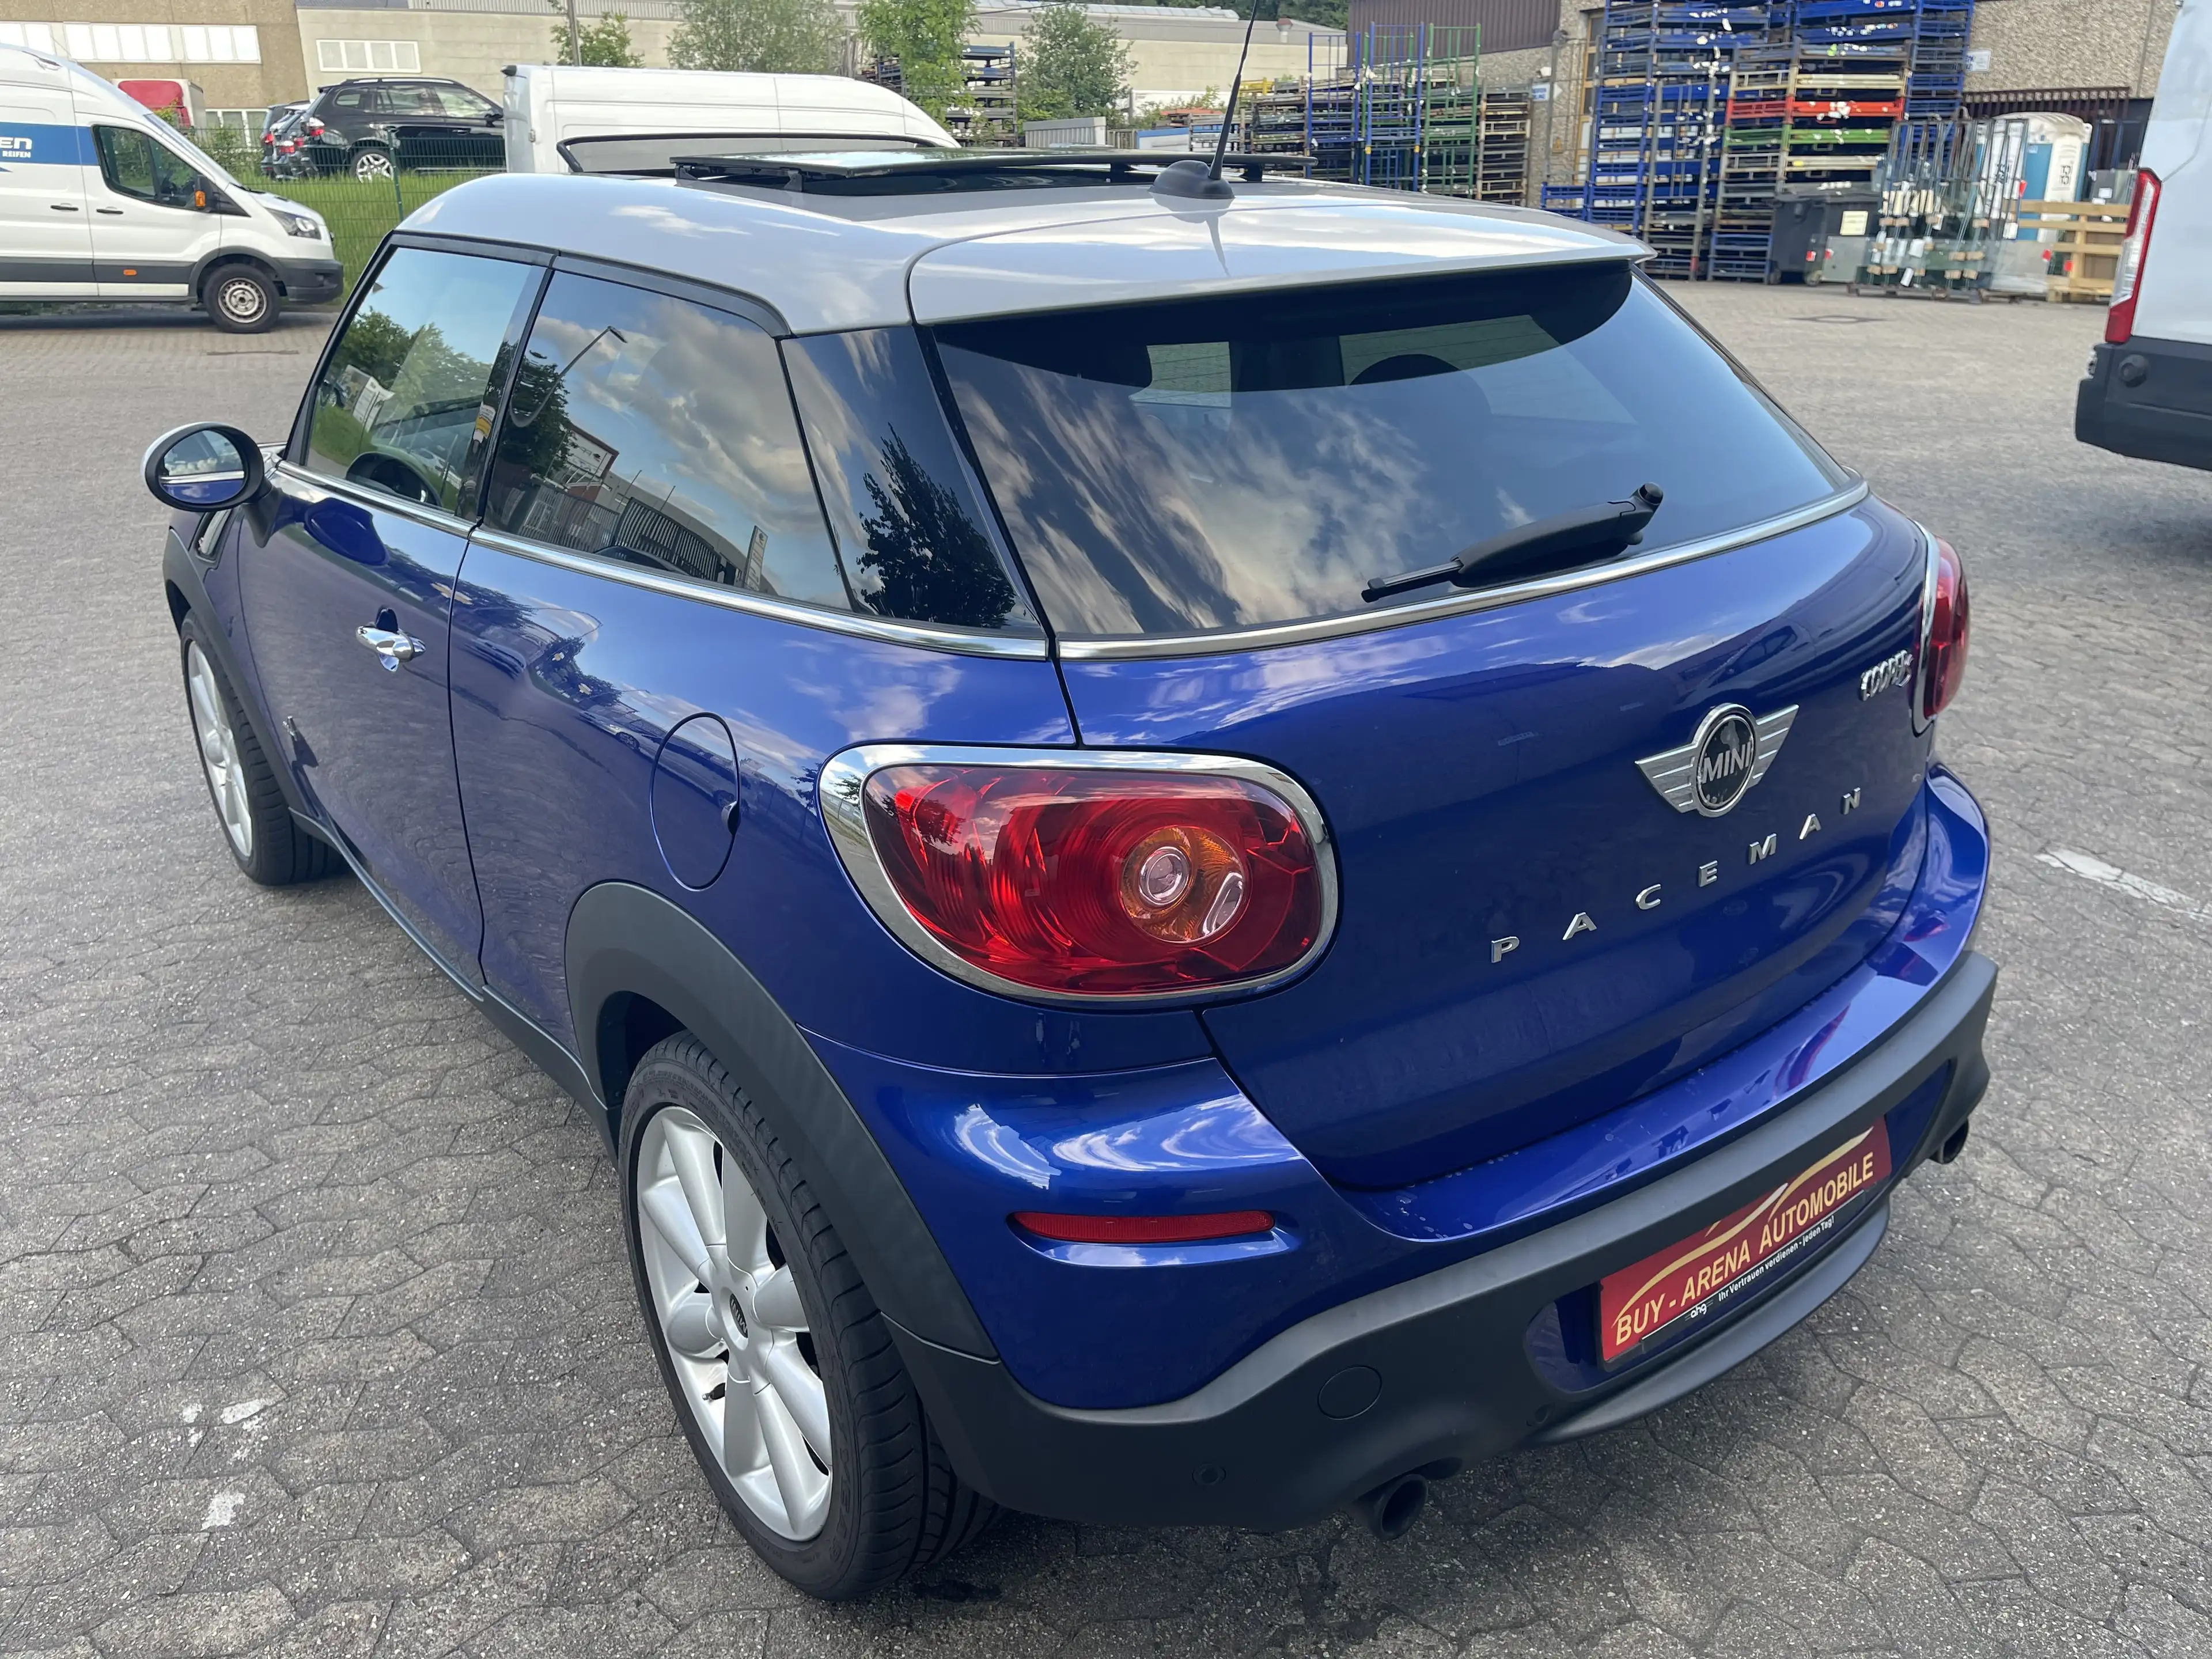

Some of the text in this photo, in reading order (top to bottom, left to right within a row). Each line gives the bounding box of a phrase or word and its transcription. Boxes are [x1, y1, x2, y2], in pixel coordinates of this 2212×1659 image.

[1701, 741, 1751, 784] MINI
[1491, 787, 1861, 964] PACEMAN
[1616, 1293, 1666, 1346] BUY
[1680, 1239, 1751, 1307] ARENA
[1759, 1152, 1874, 1255] AUTOMOBILE
[1718, 1290, 1729, 1301] Ihr
[1729, 1266, 1764, 1294] Vertrauen
[1764, 1242, 1798, 1270] verdienen
[1802, 1228, 1821, 1246] jeden
[1820, 1215, 1835, 1233] Tag!
[730, 1298, 748, 1333] MINI
